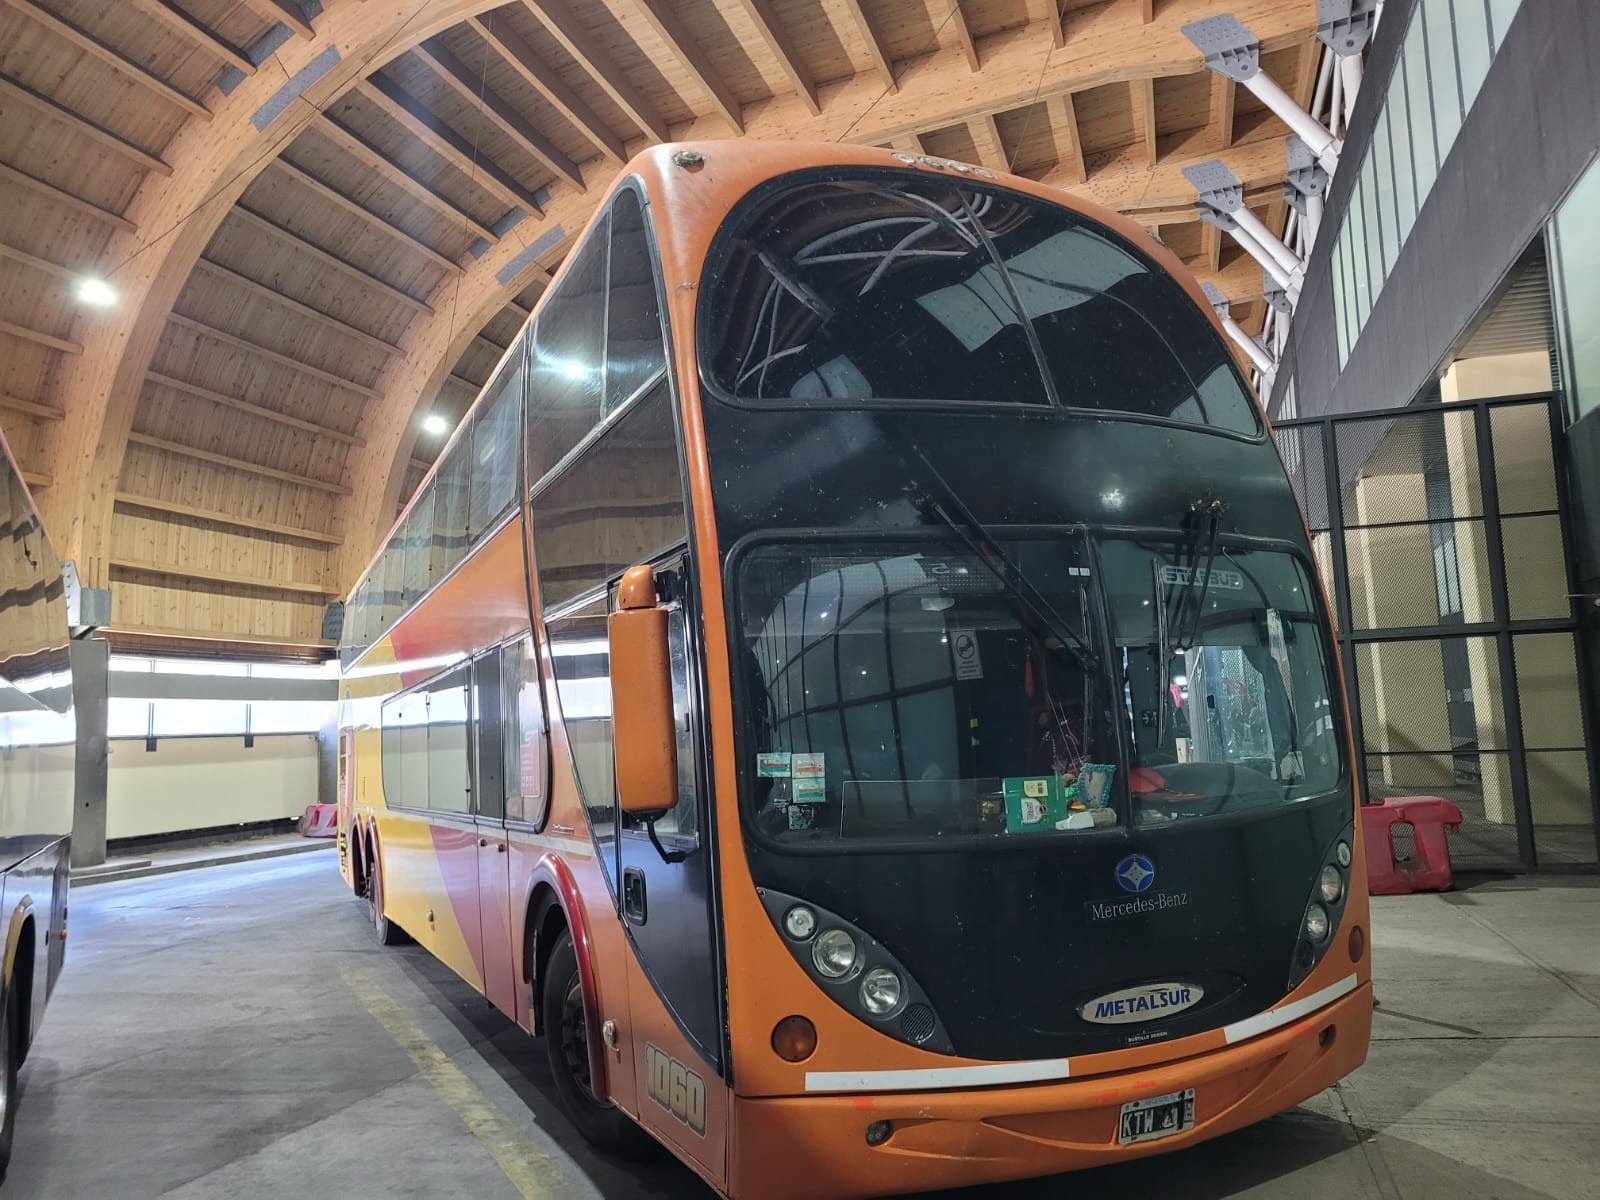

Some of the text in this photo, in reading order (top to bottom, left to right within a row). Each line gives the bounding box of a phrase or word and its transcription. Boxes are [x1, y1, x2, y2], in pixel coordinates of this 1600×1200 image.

[1092, 892, 1188, 921] Mercedes-Benz
[1094, 988, 1191, 1019] METALSUR
[646, 1043, 706, 1138] 1060
